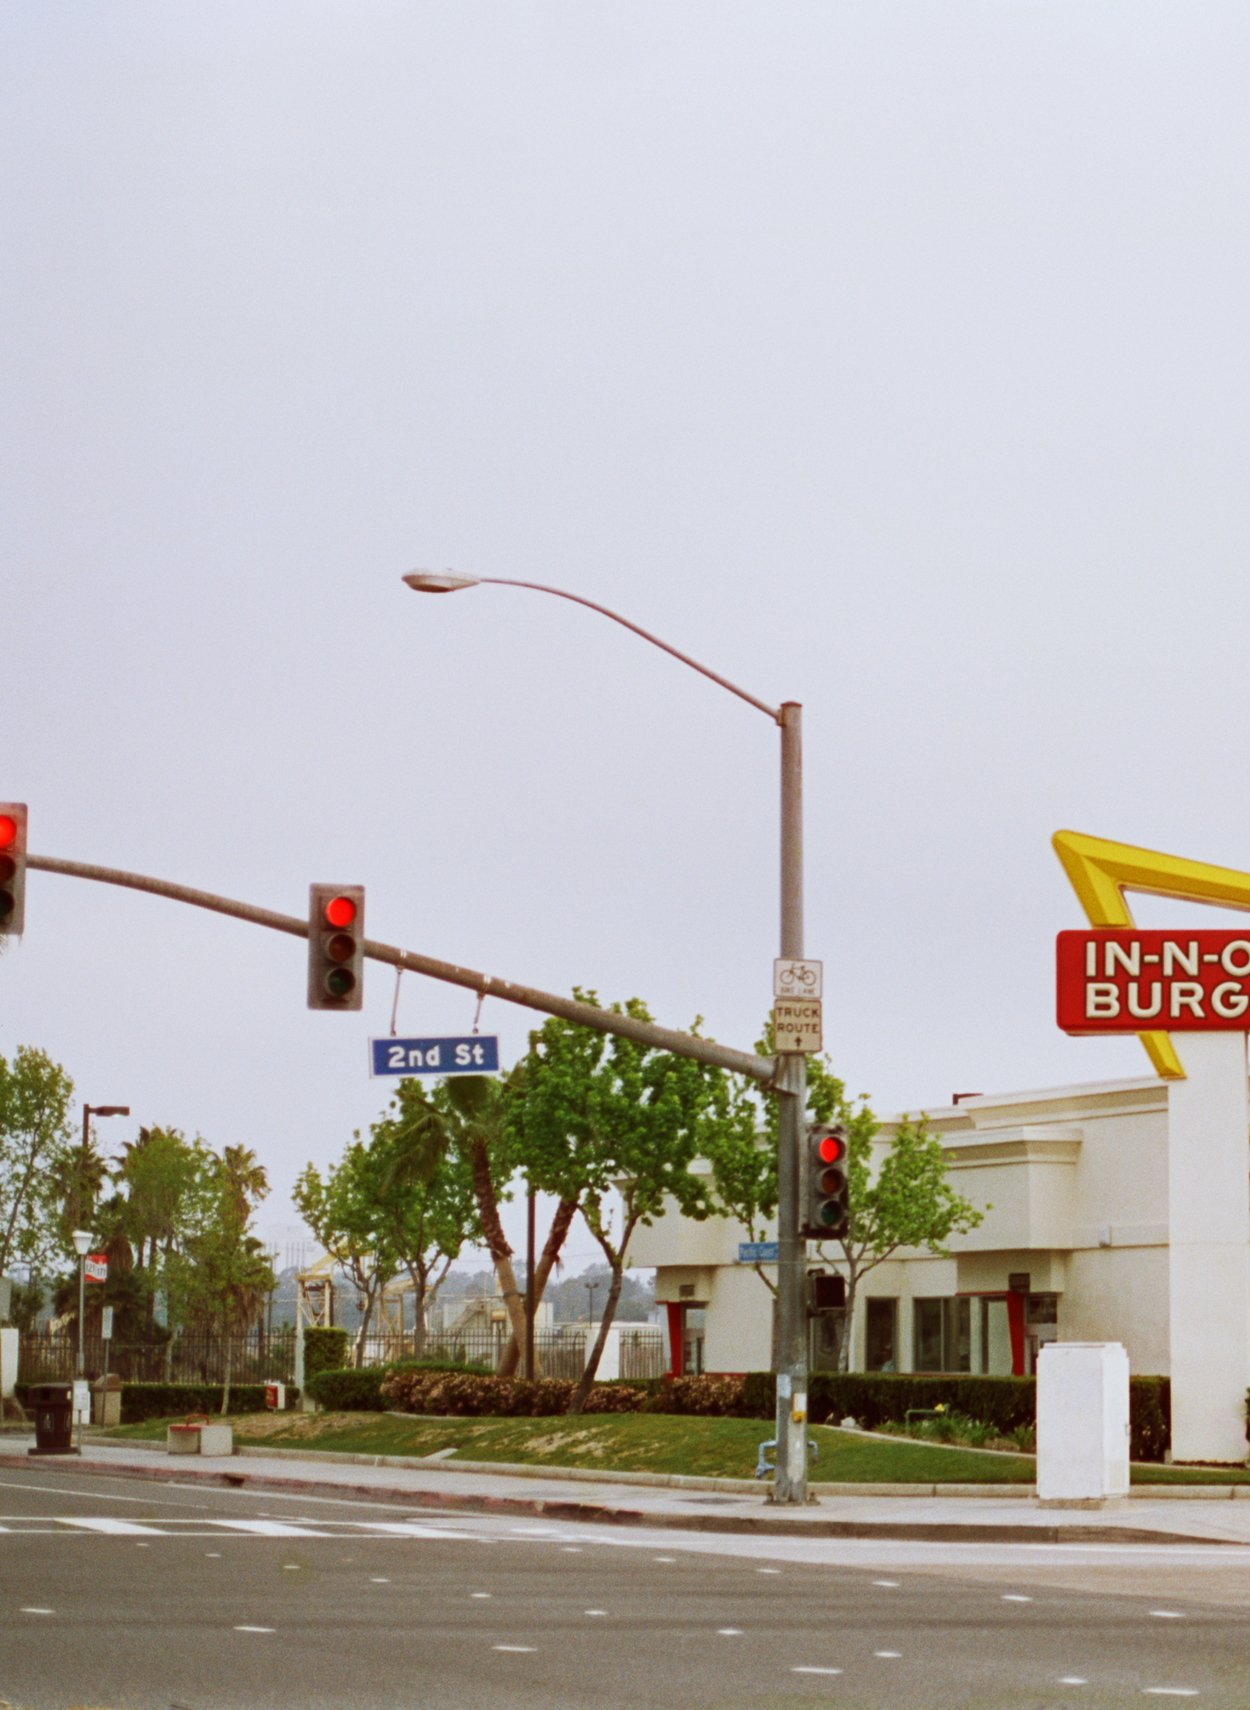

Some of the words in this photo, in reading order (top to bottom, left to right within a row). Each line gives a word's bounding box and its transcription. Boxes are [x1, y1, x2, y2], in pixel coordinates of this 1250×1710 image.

[777, 1007, 819, 1018] TRUCK
[777, 1023, 819, 1034] ROUTE
[388, 1045, 441, 1068] 2nd
[455, 1043, 484, 1066] St
